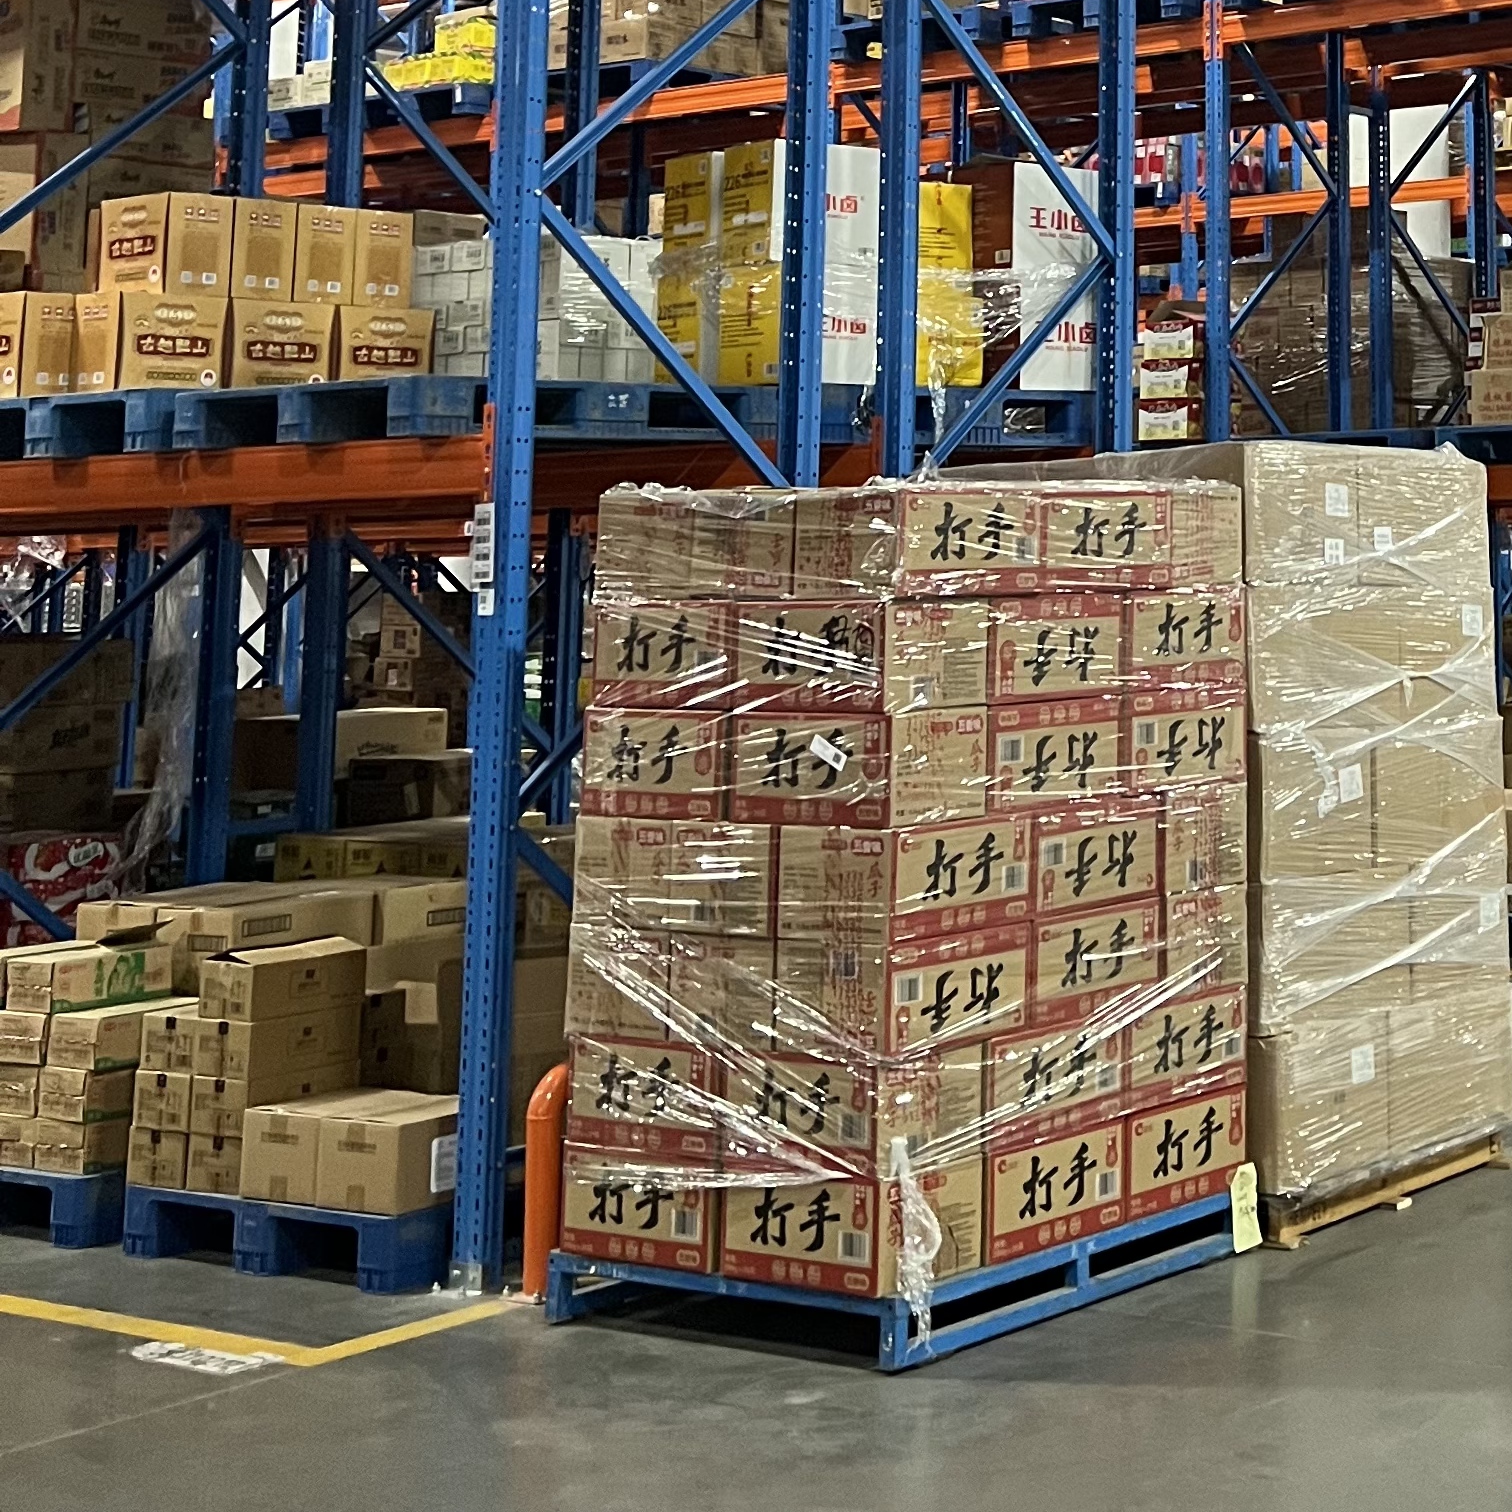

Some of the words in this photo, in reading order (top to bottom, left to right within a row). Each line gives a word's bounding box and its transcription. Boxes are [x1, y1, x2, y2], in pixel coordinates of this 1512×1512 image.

[826, 194, 858, 214] 小卤
[930, 501, 1014, 561] 打手
[1070, 502, 1147, 558] 打手
[616, 614, 696, 673] 打手
[1153, 601, 1223, 657] 打手
[606, 724, 687, 785] 打手
[762, 728, 854, 788] 打手
[921, 832, 1004, 901] 打手
[1061, 918, 1135, 988] 打手
[1154, 1004, 1223, 1074] 打手
[755, 1067, 840, 1135] 打手
[1153, 1106, 1224, 1179] 打手
[1019, 1141, 1097, 1219] 打手
[750, 1186, 841, 1252] 打手
